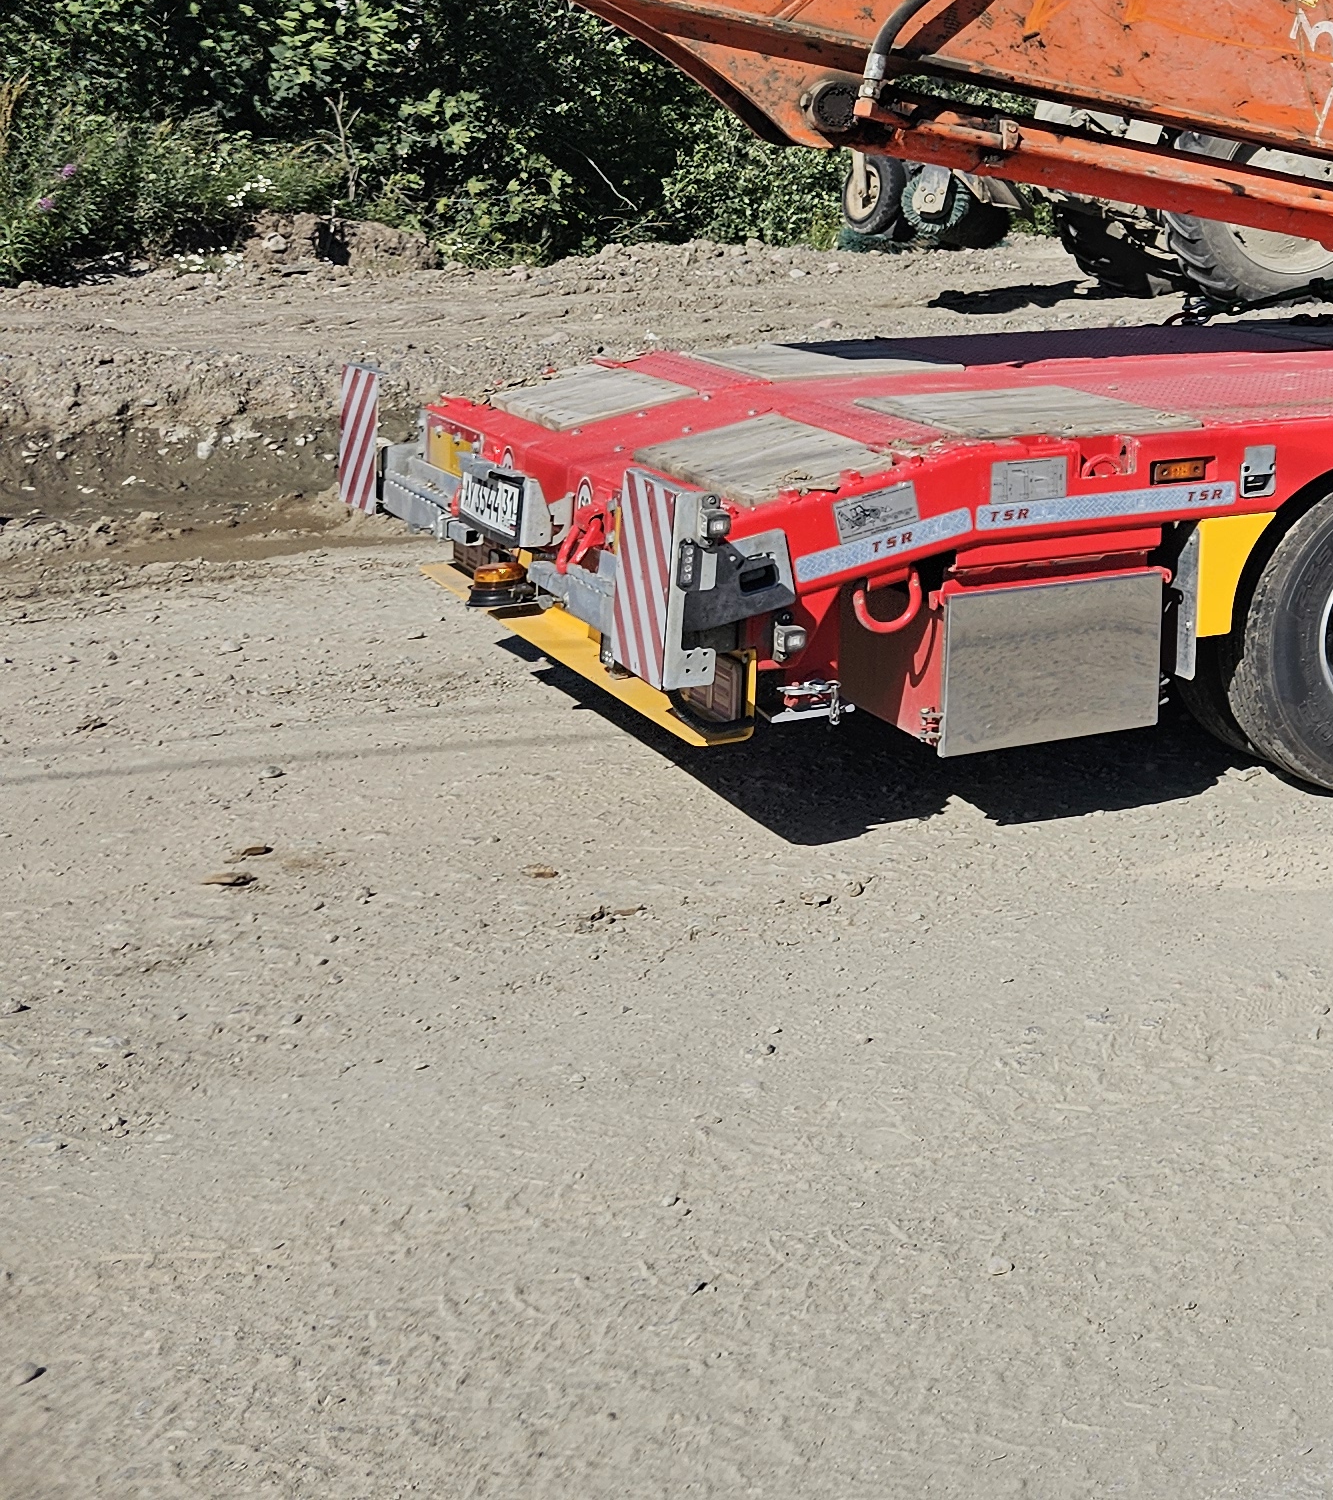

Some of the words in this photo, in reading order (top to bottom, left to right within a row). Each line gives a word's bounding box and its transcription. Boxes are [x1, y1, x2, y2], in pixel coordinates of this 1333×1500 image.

[1188, 489, 1223, 502] TSR
[990, 508, 1029, 522] TSR
[872, 531, 913, 553] TSR
